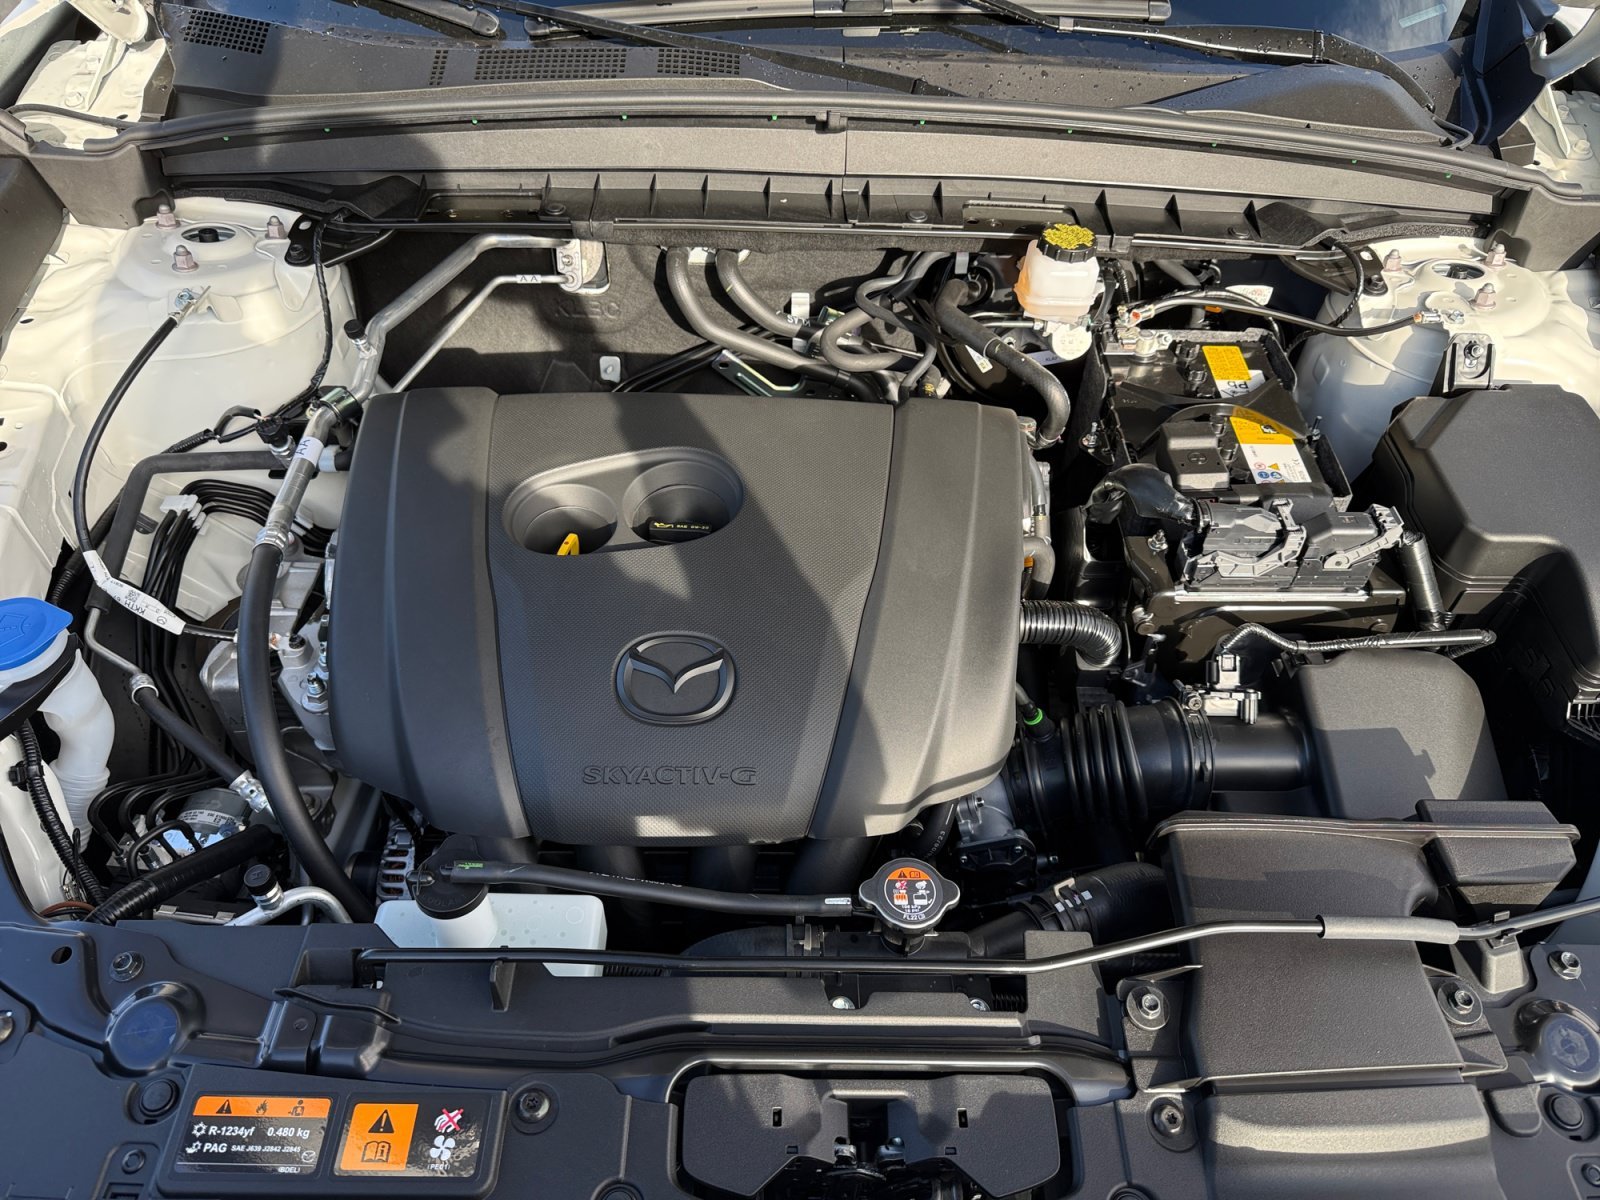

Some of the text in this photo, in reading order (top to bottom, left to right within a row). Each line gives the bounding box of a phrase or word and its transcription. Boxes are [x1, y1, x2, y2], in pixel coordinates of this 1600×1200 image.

[583, 765, 757, 786] SKYACTIV-G
[208, 1126, 310, 1139] R-1234yf 0.480 kg
[203, 1143, 228, 1153] PAG
